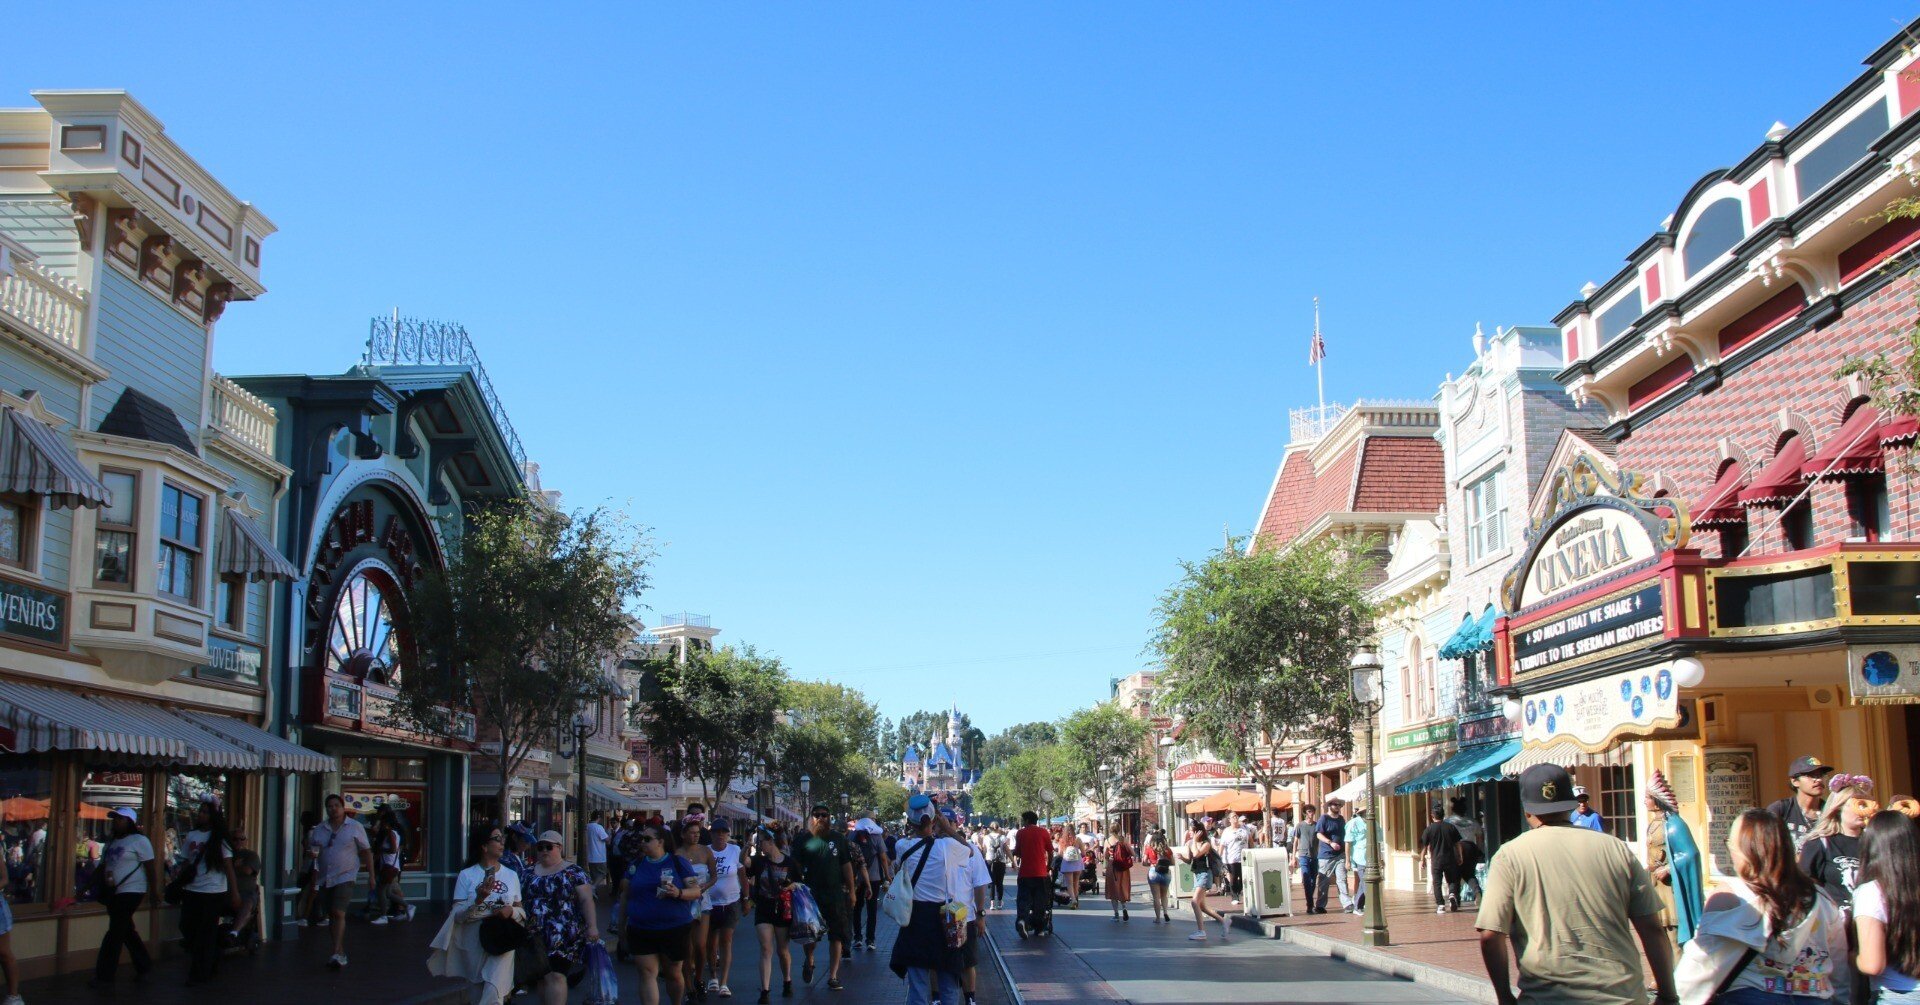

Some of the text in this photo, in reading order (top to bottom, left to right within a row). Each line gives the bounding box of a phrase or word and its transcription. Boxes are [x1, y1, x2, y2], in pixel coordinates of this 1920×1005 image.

[1536, 524, 1632, 595] CINEMA
[1514, 615, 1664, 673] A TRIBUTE TO THE SHERMAN BROTHERS
[1533, 598, 1632, 643] SO MUCH THAT WE SHARE
